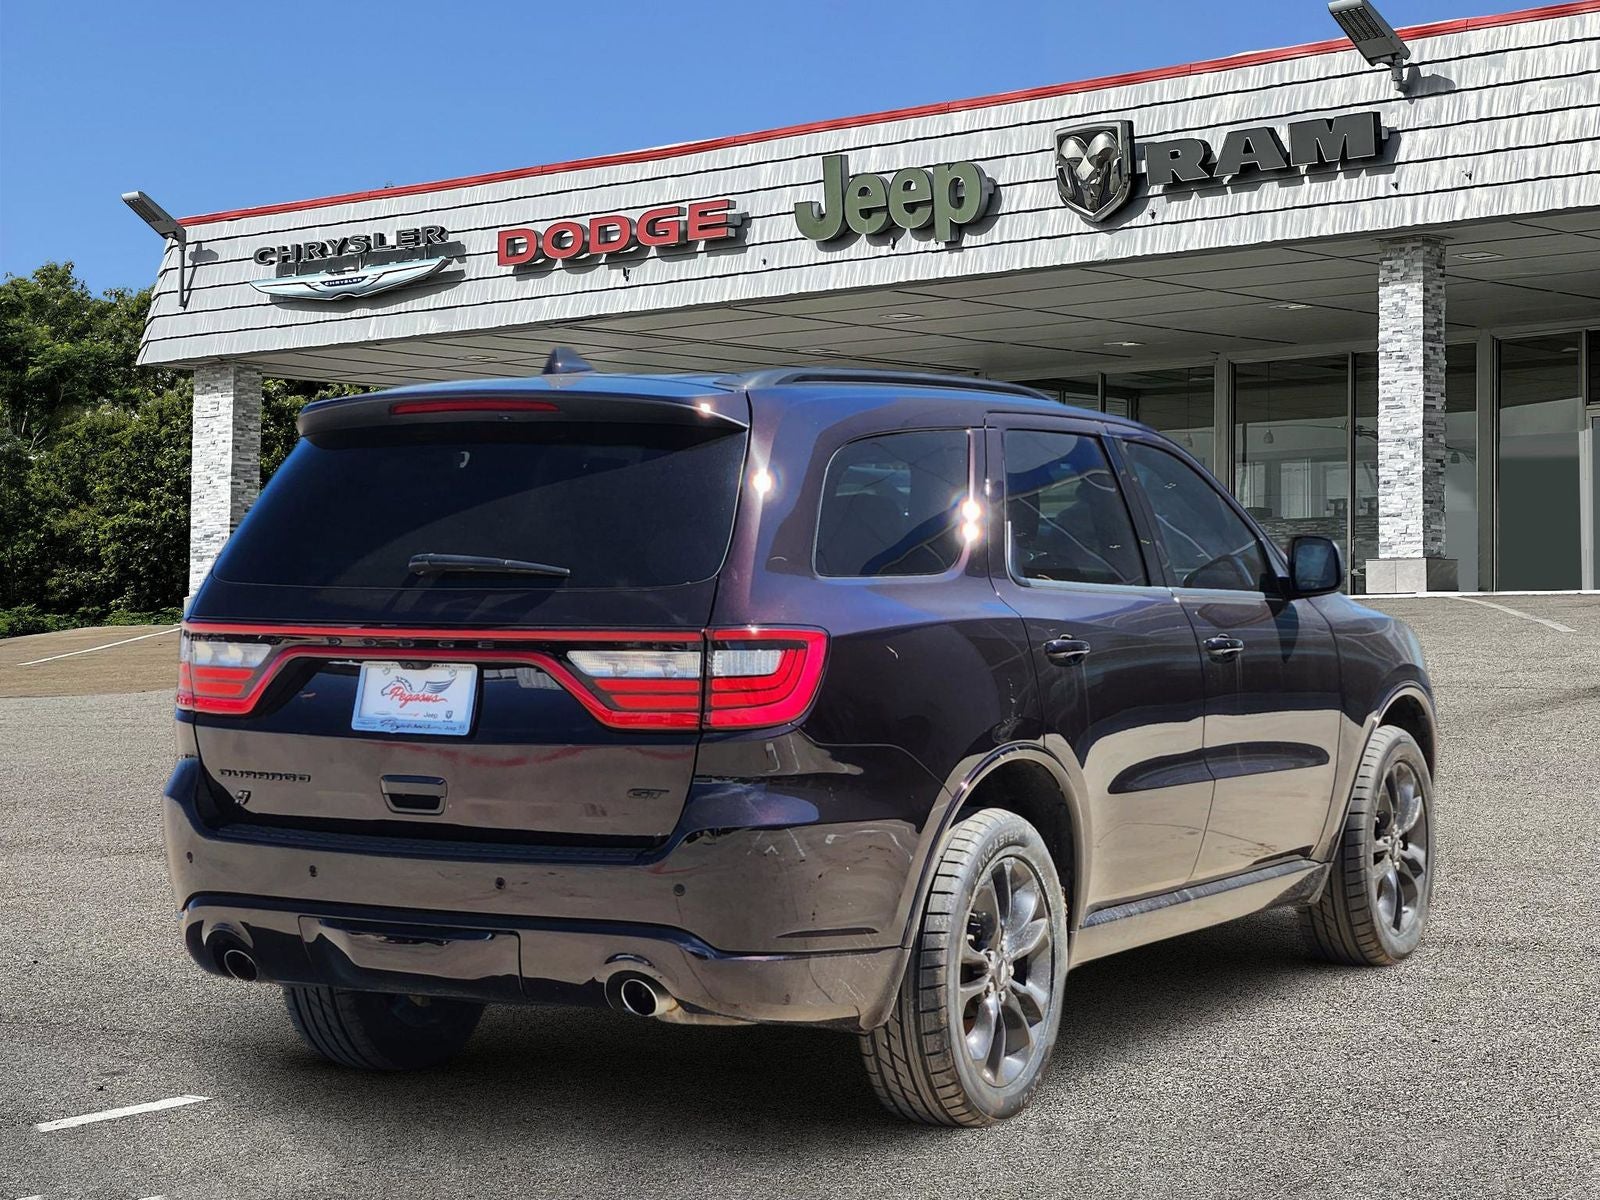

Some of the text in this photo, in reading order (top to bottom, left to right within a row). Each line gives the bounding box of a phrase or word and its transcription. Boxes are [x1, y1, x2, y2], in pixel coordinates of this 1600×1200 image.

[1146, 111, 1380, 186] RAM
[794, 154, 986, 242] Jeep
[253, 225, 449, 266] CHRYSLER
[497, 199, 736, 266] DODGE
[390, 685, 449, 709] Pegasus
